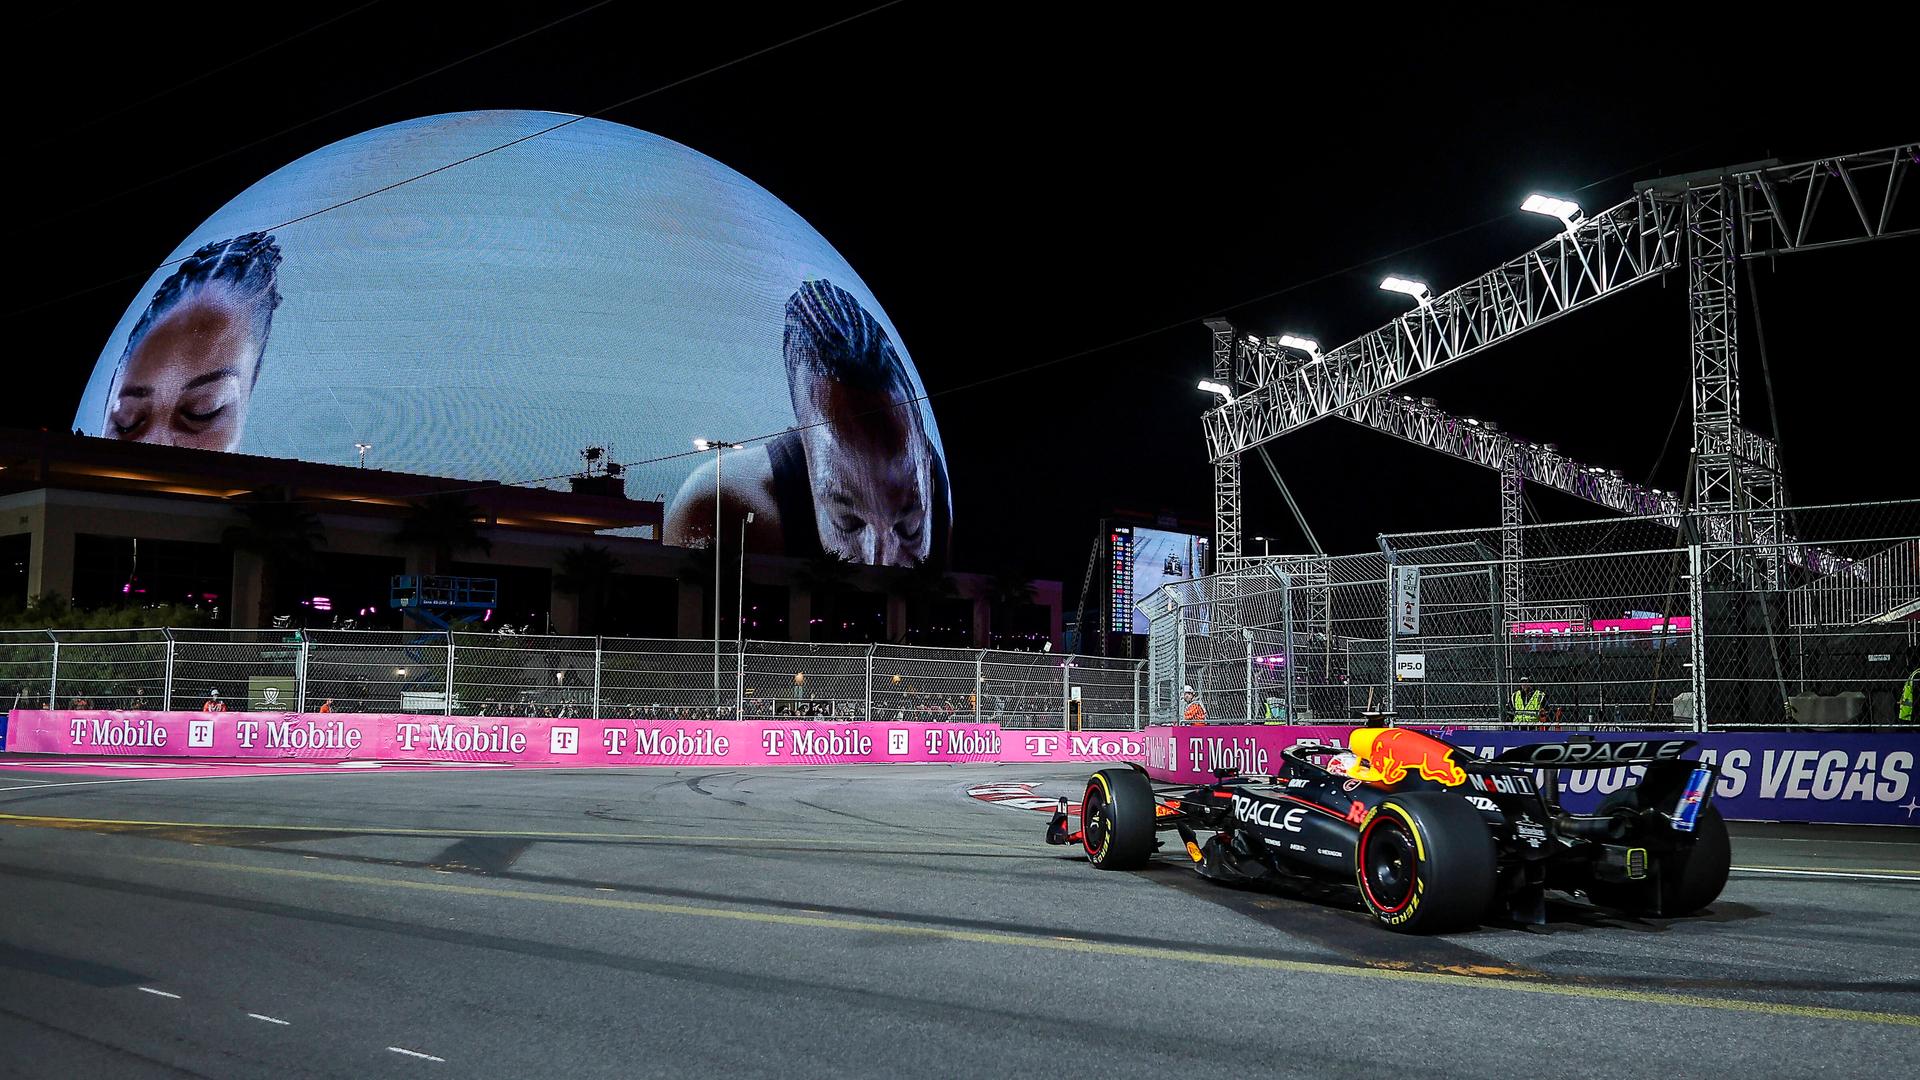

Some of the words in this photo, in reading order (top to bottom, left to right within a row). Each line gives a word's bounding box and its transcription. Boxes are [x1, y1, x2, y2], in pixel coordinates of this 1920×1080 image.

[1397, 662, 1423, 671] IP5.0
[91, 719, 168, 747] Mobile
[265, 722, 362, 749] Mobile
[427, 724, 527, 753] Mobile
[634, 728, 730, 756] Mobile
[791, 729, 872, 756] Mobile
[947, 730, 1001, 755] Mobile
[1069, 737, 1146, 756] Mobi
[1207, 738, 1269, 775] Mobile
[1530, 741, 1685, 762] ORACLE
[1468, 774, 1517, 794] Mobil
[1759, 749, 1914, 802] VEGAS
[1231, 794, 1309, 832] ORACLE
[1391, 893, 1420, 925] ZERO
